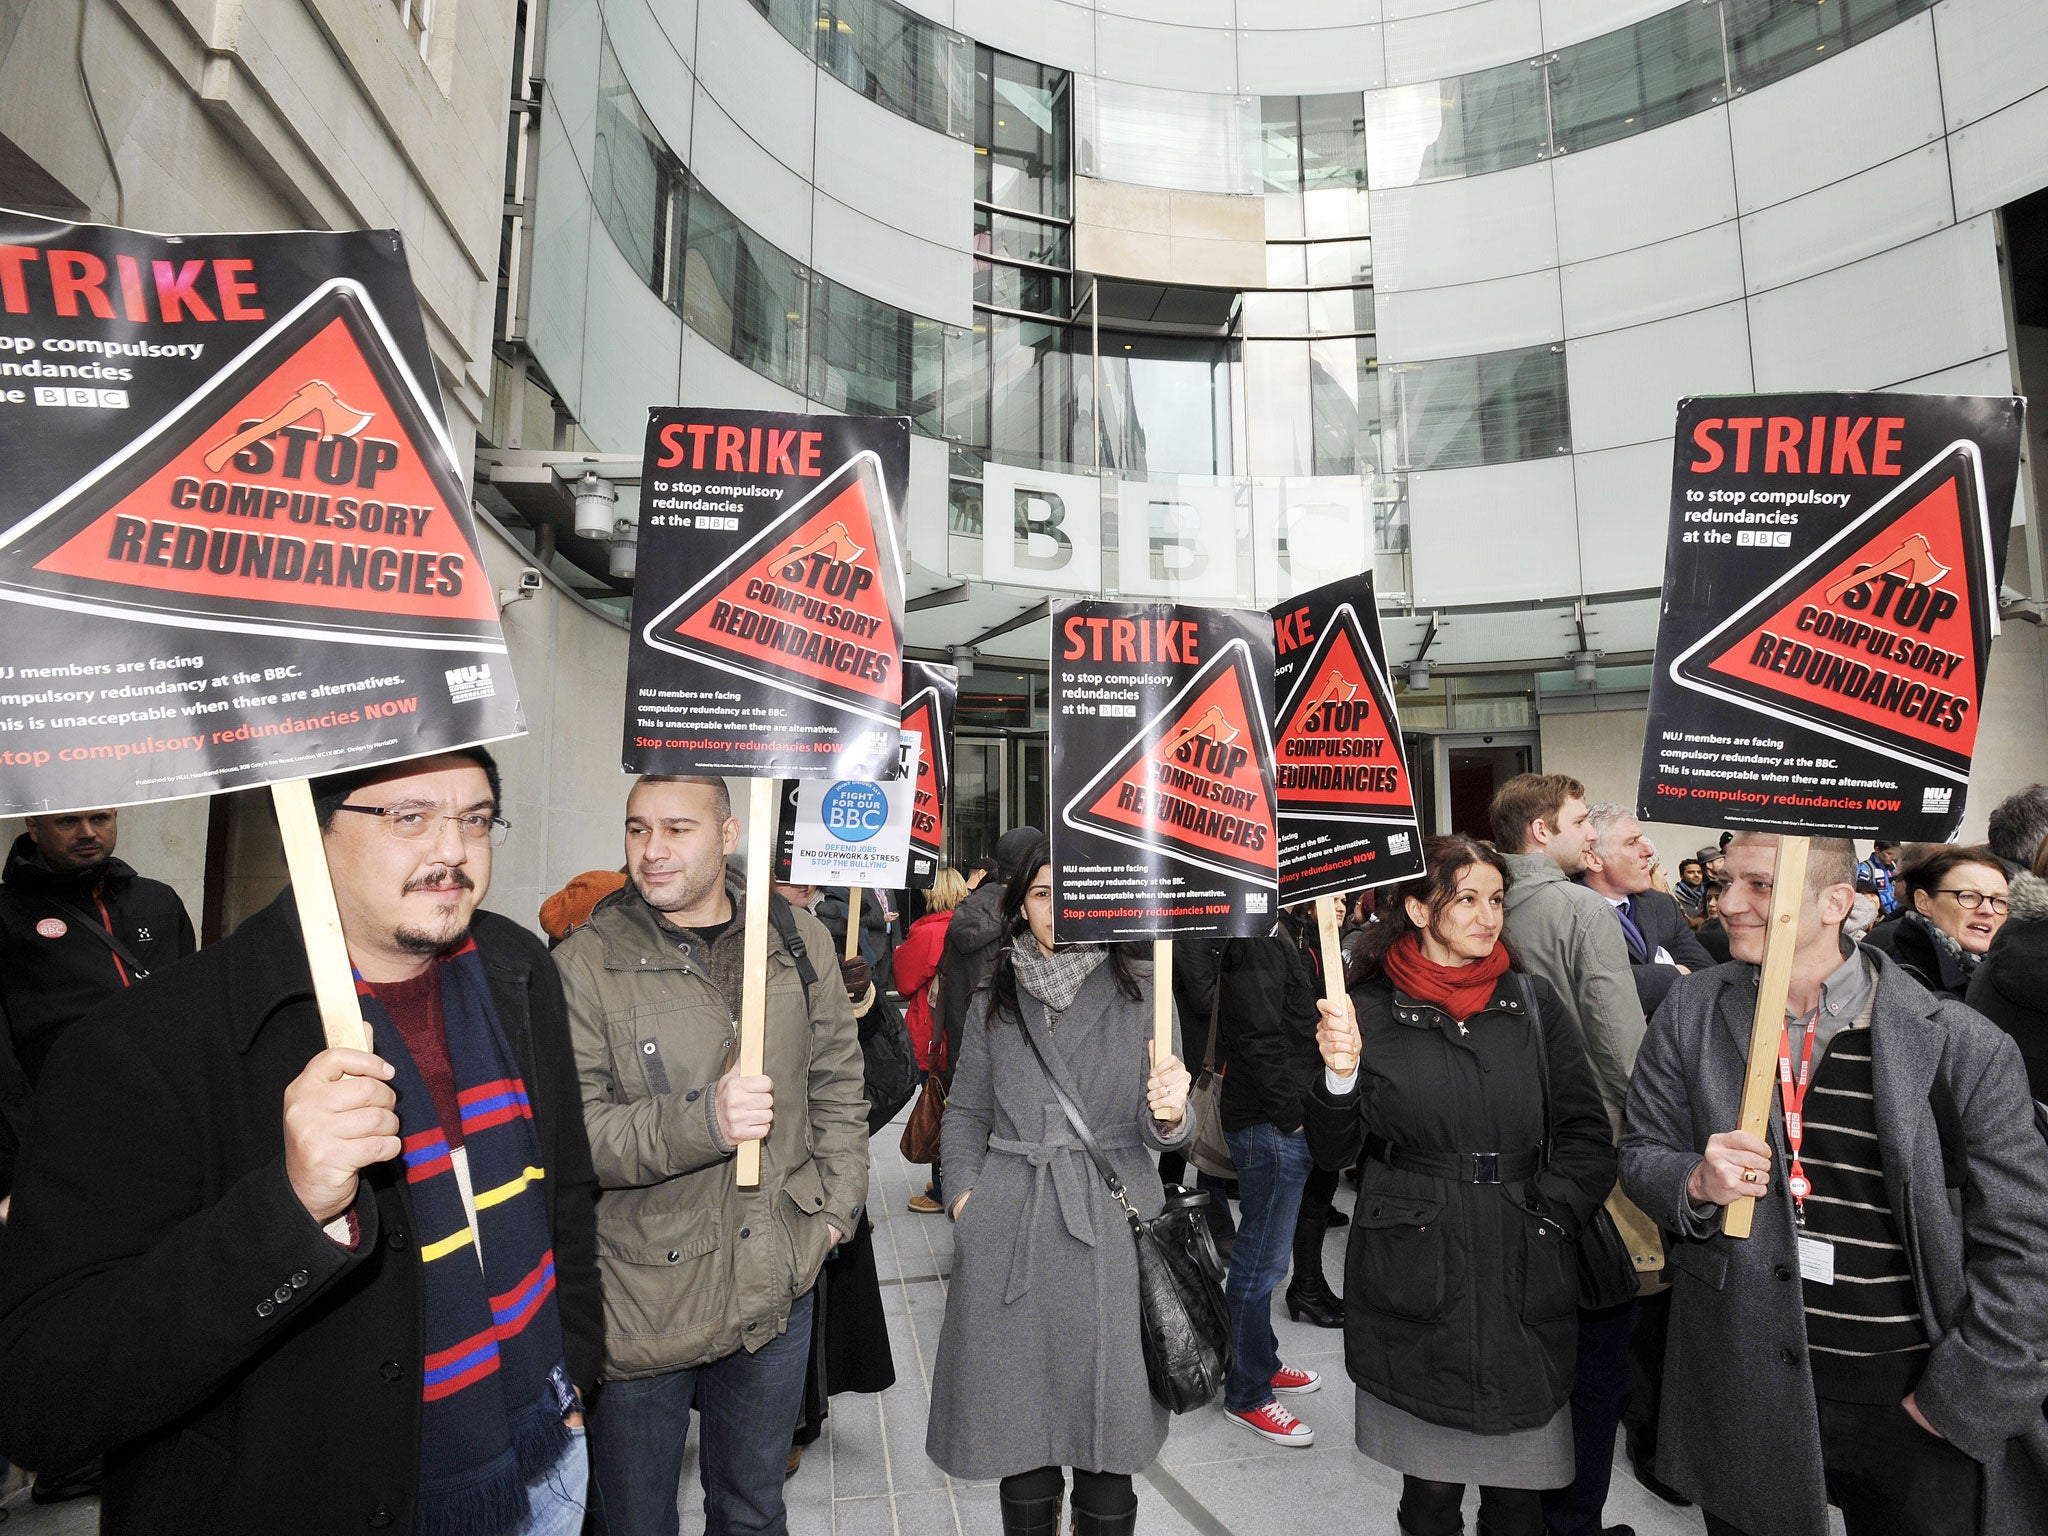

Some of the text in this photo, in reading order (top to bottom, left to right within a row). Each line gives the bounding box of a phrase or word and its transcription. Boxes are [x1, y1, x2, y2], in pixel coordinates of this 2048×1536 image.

[42, 336, 204, 361] compulsory
[0, 359, 133, 382] ndancies
[37, 387, 128, 407] BBC
[233, 421, 399, 489] STOP
[657, 424, 823, 477] STRIKE
[1690, 416, 1905, 475] STRIKE
[654, 480, 784, 500] to stop compulsory
[1686, 489, 1851, 508] to stop compulsory
[172, 477, 434, 538] COMPULSORY
[653, 498, 744, 512] redundancies
[651, 514, 738, 530] at the BBC
[1685, 509, 1798, 525] redundancies
[1682, 529, 1790, 546] at the BBC
[108, 515, 464, 597] REDUNDANCIES
[783, 545, 874, 602] STOP
[745, 579, 883, 639] COMPULSORY
[1842, 563, 1958, 635] STOP
[710, 601, 892, 684] REDUNDANCIES
[1063, 616, 1199, 665] STRIKE
[1796, 604, 1965, 681] COMPULSORY
[20, 664, 111, 679] members
[115, 661, 145, 673] are
[149, 655, 204, 670] facing
[445, 663, 490, 686] NUJ
[0, 665, 302, 707] mpulsory redundancy at the BBC.
[1062, 672, 1173, 686] to stop compulsory
[1749, 630, 1969, 734] REDUNDANCIES
[28, 674, 405, 730] is unacceptable when there are alternatives.
[639, 688, 656, 697] NUJ
[658, 690, 697, 698] members
[715, 691, 741, 701] facing
[1062, 688, 1139, 700] redundancies
[638, 704, 688, 714] compulsory
[690, 706, 740, 716] redundancy
[752, 708, 766, 716] the
[768, 708, 788, 717] BBC.
[1062, 703, 1135, 716] at the BBC
[1305, 700, 1370, 733] STOP
[58, 696, 418, 762] compulsory redundancies NOW
[637, 719, 655, 727] This
[656, 719, 663, 727] is
[665, 720, 721, 731] unacceptable
[724, 722, 747, 730] when
[749, 722, 771, 731] there
[789, 724, 839, 734] alternatives.
[636, 737, 843, 753] Stop compulsory redundancies NOW
[1285, 738, 1384, 758] COMPULSORY
[1662, 731, 1784, 750] NUJ members are facing
[1177, 728, 1248, 779] STOP
[1660, 749, 1838, 769] compulsory redundancy at the BBC.
[1151, 760, 1259, 812] COMPULSORY
[1659, 764, 1898, 790] This is unacceptable when there are alternatives.
[840, 791, 874, 800] FIGHT
[1657, 783, 1901, 812] Stop compulsory redundancies NOW
[1923, 787, 1953, 800] NUJ
[833, 799, 880, 809] FOR OUR
[829, 807, 880, 830] BBC
[825, 843, 877, 853] DEFEND JOBS
[1334, 838, 1370, 853] alternatives.
[1387, 831, 1408, 845] NUJ
[800, 849, 816, 857] END
[818, 850, 861, 859] OVERWORK
[870, 854, 900, 863] STRESS
[811, 858, 887, 869] STOP THE BULLYING
[1301, 857, 1352, 877] redundancies
[1353, 851, 1376, 864] NOW
[1063, 865, 1077, 873] NUJ
[1079, 865, 1111, 873] members
[1126, 864, 1148, 874] facing
[1063, 878, 1104, 888] compulsory
[1106, 877, 1149, 887] redundancy
[1159, 878, 1171, 886] the
[1063, 892, 1078, 901] This
[1079, 892, 1085, 900] is
[1086, 891, 1134, 902] unacceptable
[1135, 891, 1155, 900] when
[1157, 890, 1175, 899] there
[1186, 889, 1226, 898] alternatives.
[1245, 893, 1267, 902] NUJ
[1063, 904, 1230, 919] Stop compulsory redundancies NOW
